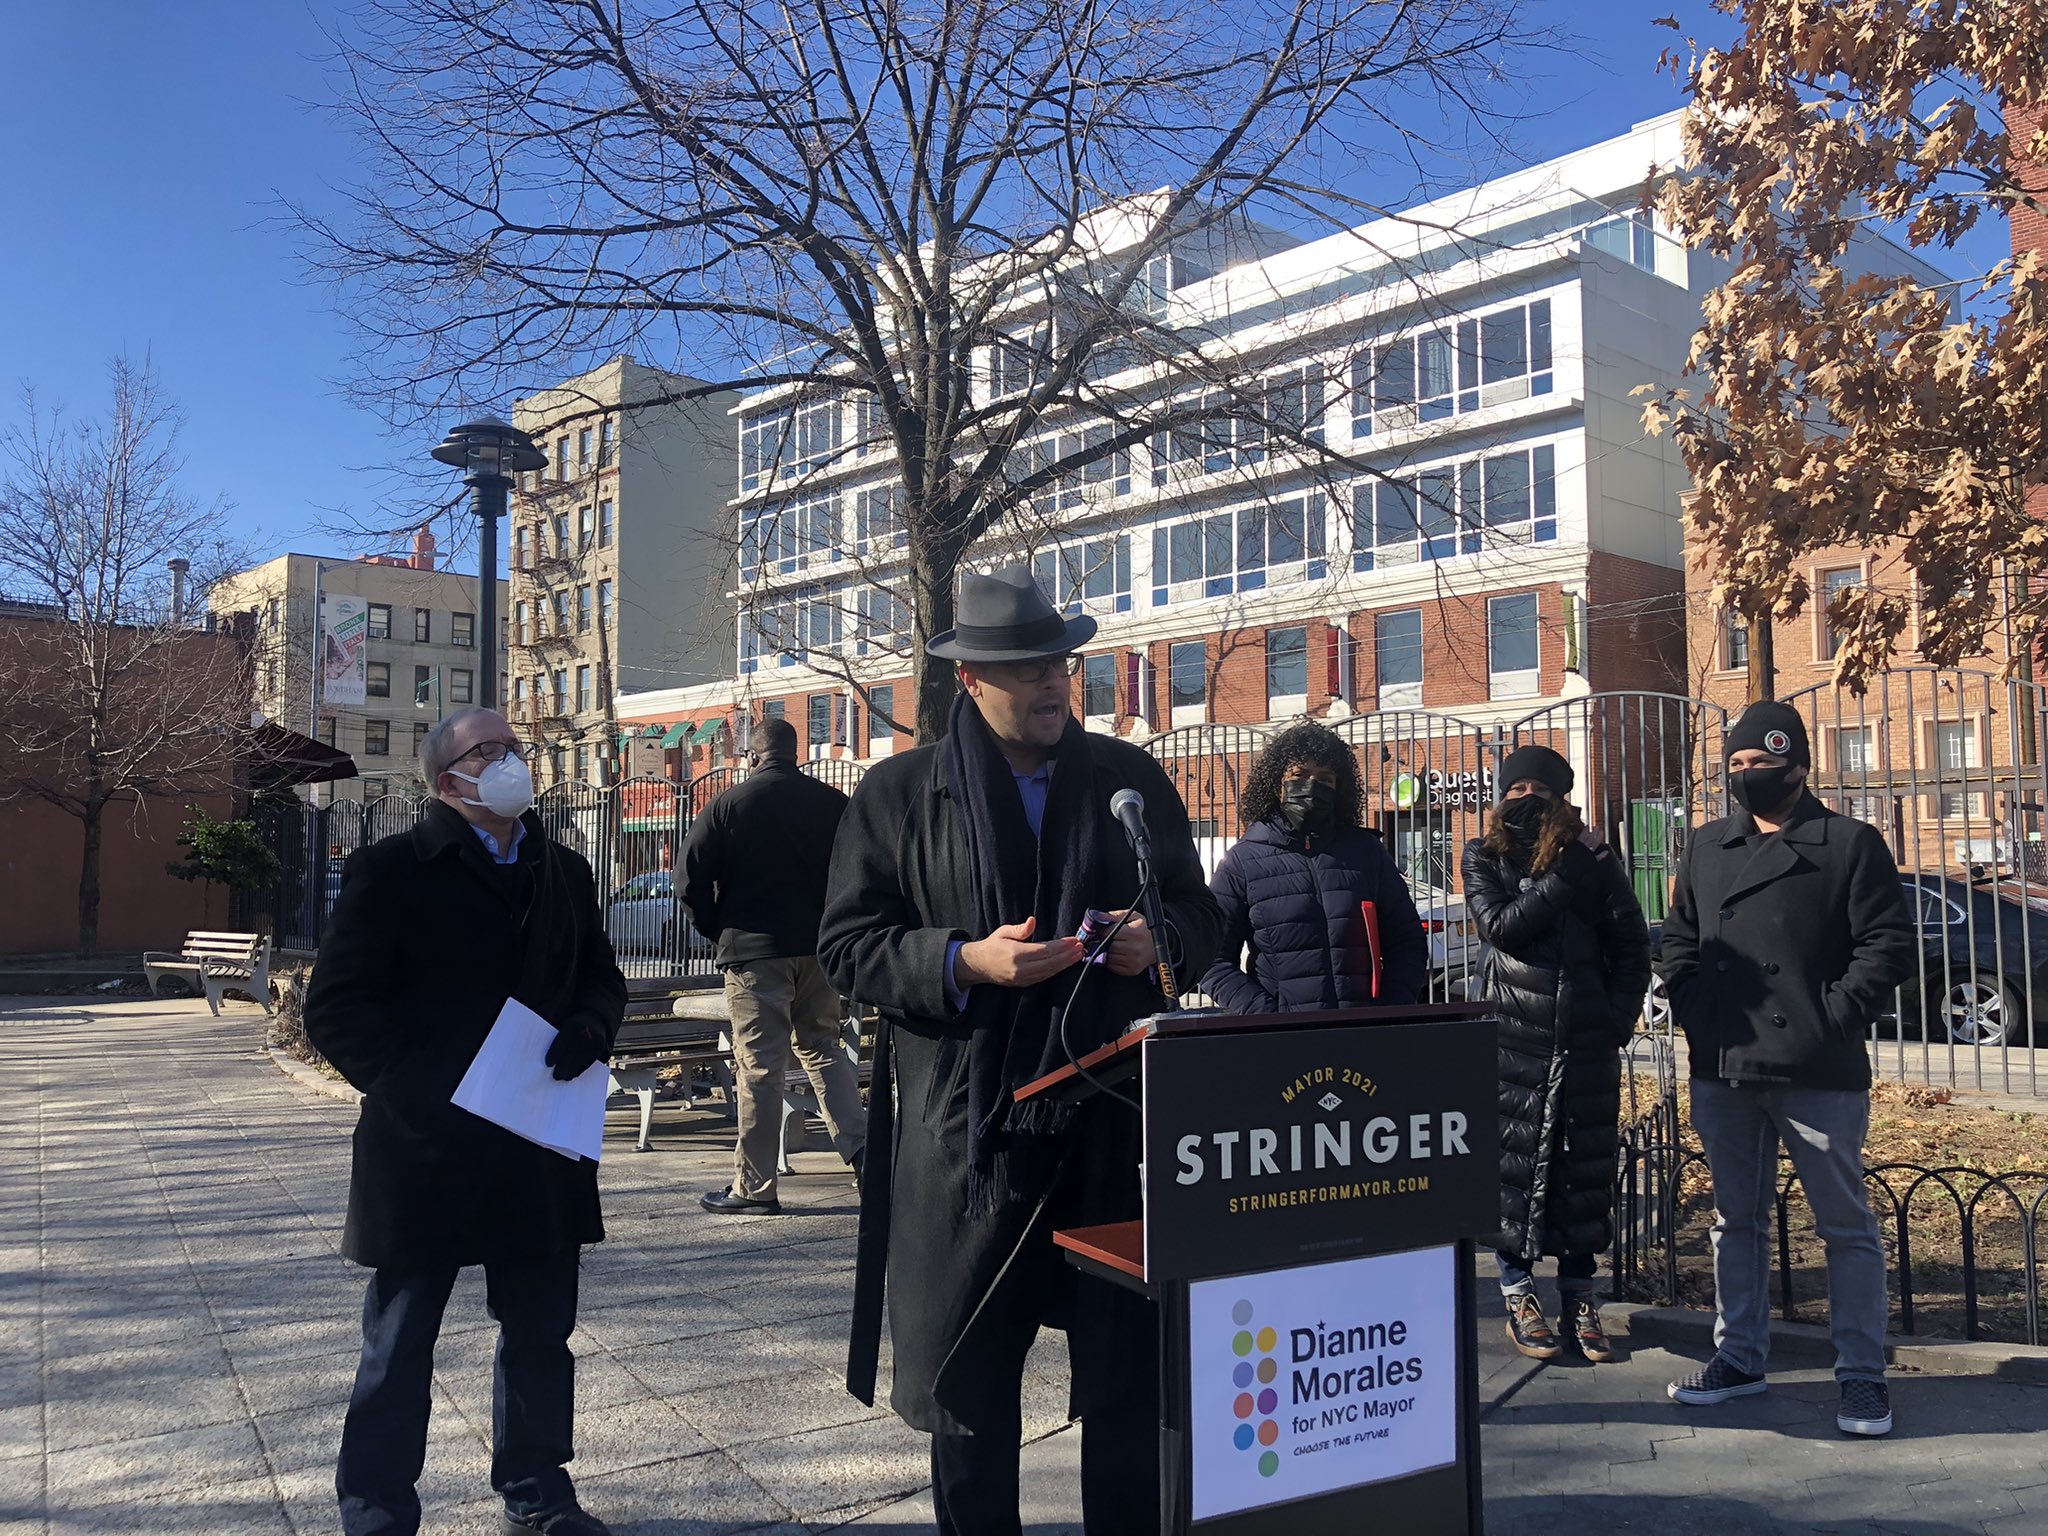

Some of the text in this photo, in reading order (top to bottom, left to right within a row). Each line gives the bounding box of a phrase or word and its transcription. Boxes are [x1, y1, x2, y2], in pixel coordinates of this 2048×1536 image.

[335, 616, 361, 633] BRONX
[340, 625, 362, 641] LITTLE
[343, 634, 363, 650] ITALY
[1425, 767, 1492, 789] Quest
[1428, 789, 1502, 806] Diagnost
[1159, 962, 1177, 1000] auray
[1281, 1067, 1377, 1103] MAYOR 2021
[1322, 1096, 1338, 1106] NYC
[1175, 1111, 1471, 1185] STRINGER
[1229, 1176, 1429, 1213] STRINGERFORMAYOR.COM
[1290, 1320, 1407, 1363] Dianne
[1292, 1354, 1422, 1405] Morales
[1292, 1396, 1415, 1434] for NYC Mayor
[1293, 1427, 1390, 1456] CHOOSE THE FUTURE
